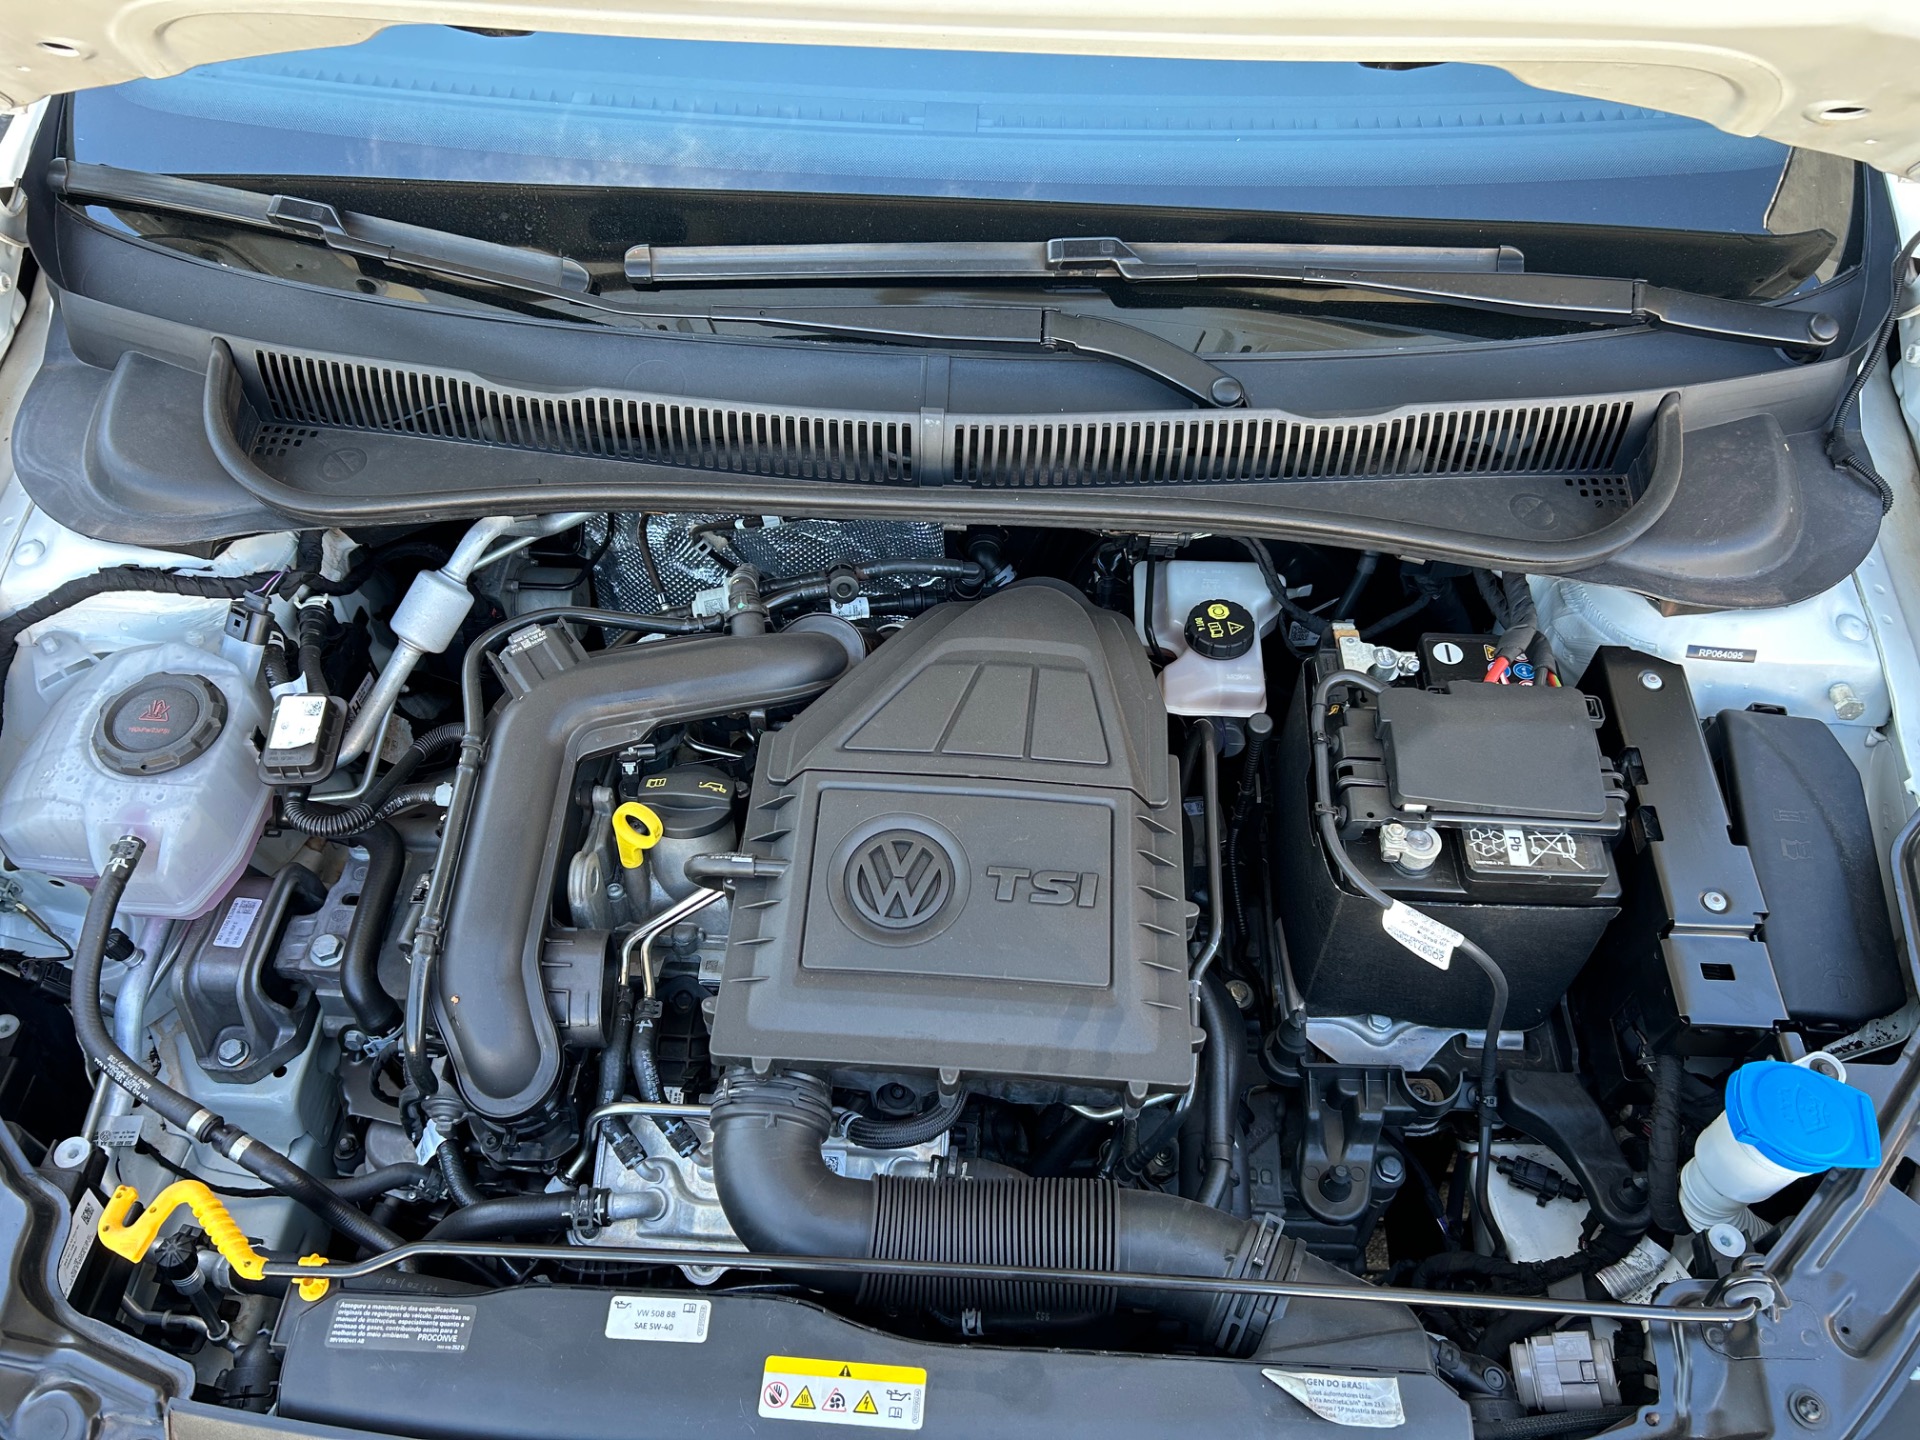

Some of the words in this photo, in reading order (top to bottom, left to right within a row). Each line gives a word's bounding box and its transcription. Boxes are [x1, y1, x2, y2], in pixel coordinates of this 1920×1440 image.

[1698, 648, 1744, 660] RP064095
[1508, 836, 1522, 852] Pb
[986, 866, 1099, 908] TSI
[417, 1333, 458, 1342] PROCONVE
[1326, 1380, 1339, 1388] DO
[1342, 1381, 1370, 1390] BRASIL
